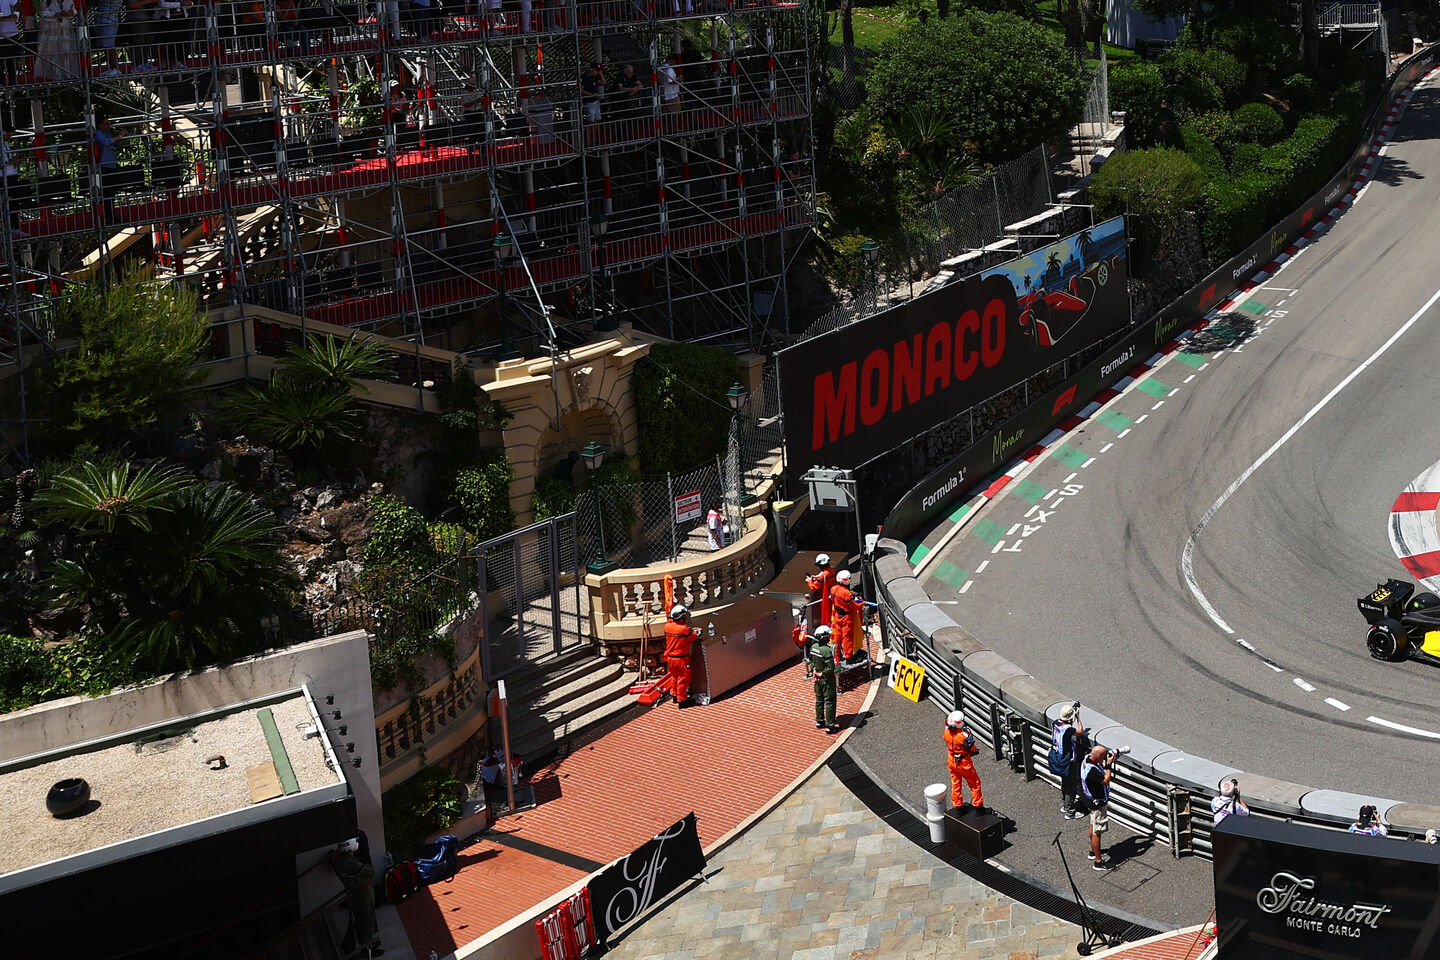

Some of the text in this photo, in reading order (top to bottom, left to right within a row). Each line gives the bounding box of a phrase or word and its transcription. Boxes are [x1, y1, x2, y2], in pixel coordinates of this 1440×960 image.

[1232, 259, 1252, 280] Formula
[811, 298, 1007, 451] MONACO
[1101, 351, 1129, 378] Formula
[992, 429, 1025, 463] Monaco
[922, 476, 958, 511] Formula
[1003, 484, 1084, 552] TAXIS
[897, 662, 921, 695] FCY
[1256, 872, 1392, 929] Fairmont
[1287, 917, 1361, 939] MONTE CARLO
